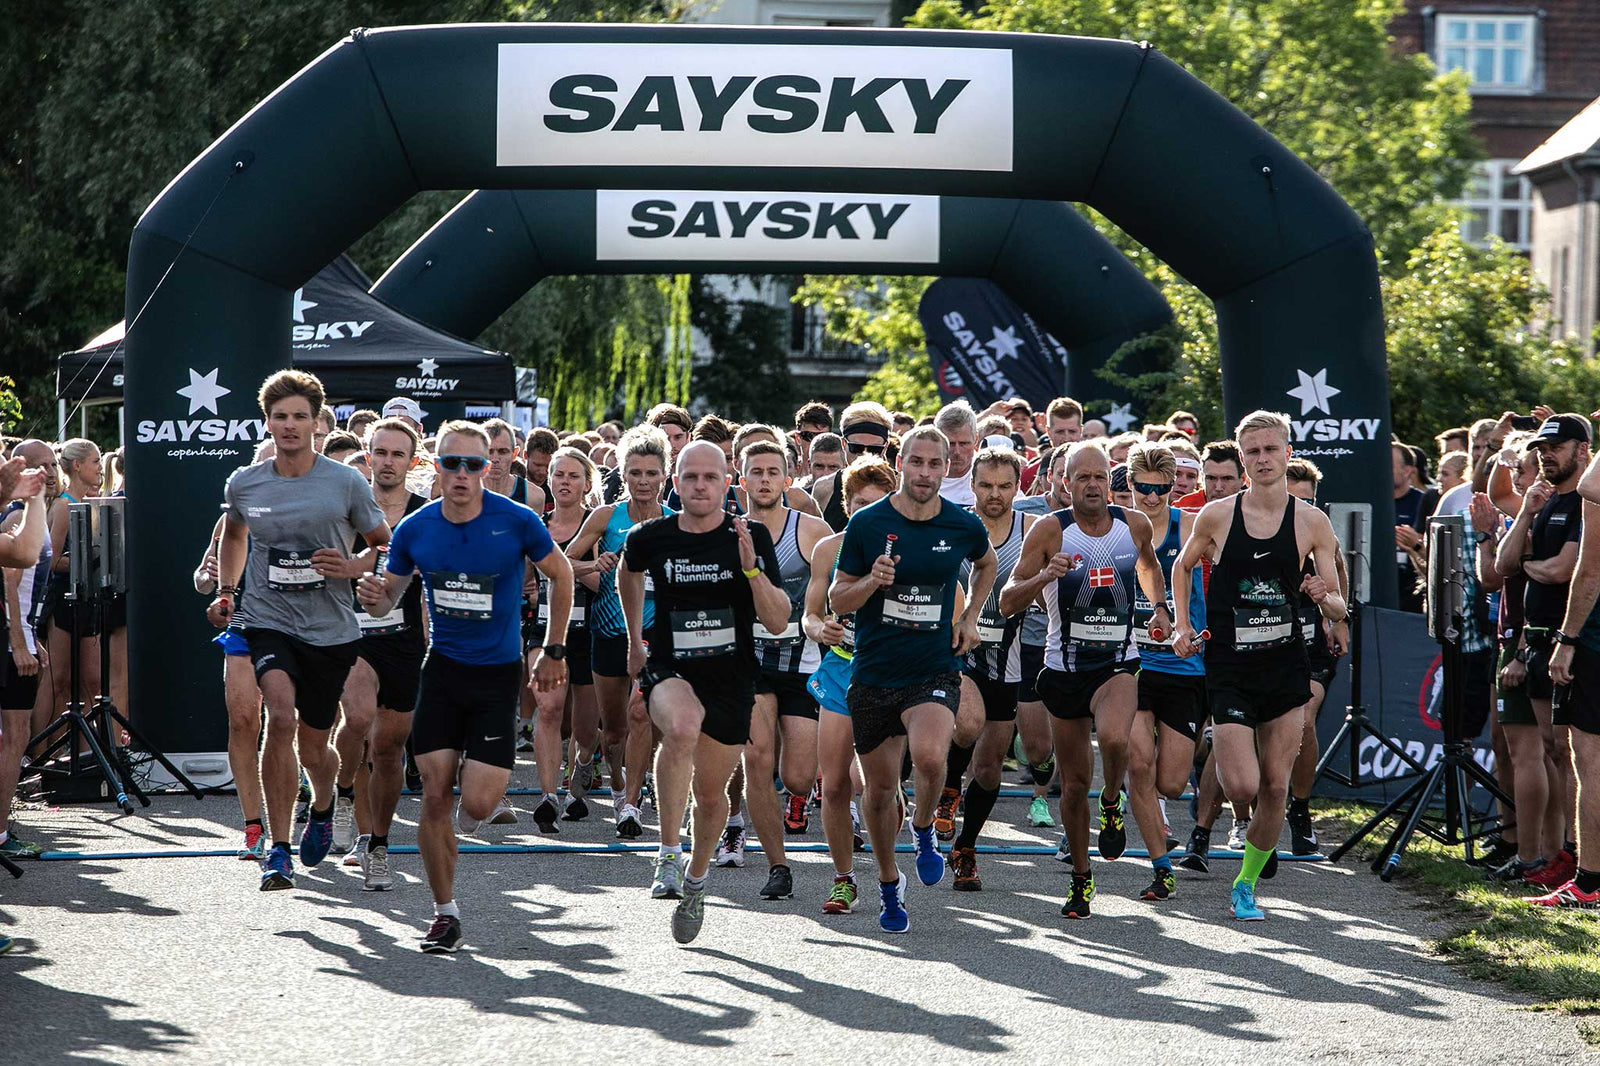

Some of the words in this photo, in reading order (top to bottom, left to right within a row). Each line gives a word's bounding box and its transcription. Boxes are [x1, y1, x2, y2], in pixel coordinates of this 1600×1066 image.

[544, 74, 971, 134] SAYSKY
[627, 199, 910, 239] SAYSKY
[395, 376, 460, 391] SAYSKY
[136, 418, 269, 443] SAYSKY
[1288, 418, 1381, 442] YSKY
[167, 446, 240, 460] copenhagen
[675, 563, 719, 573] Distance
[675, 569, 734, 583] Running.dk
[445, 580, 463, 589] COP
[463, 582, 481, 590] RUN
[898, 594, 914, 602] COP
[704, 619, 721, 627] RUN
[979, 617, 995, 625] RUN
[1359, 734, 1425, 778] COP
